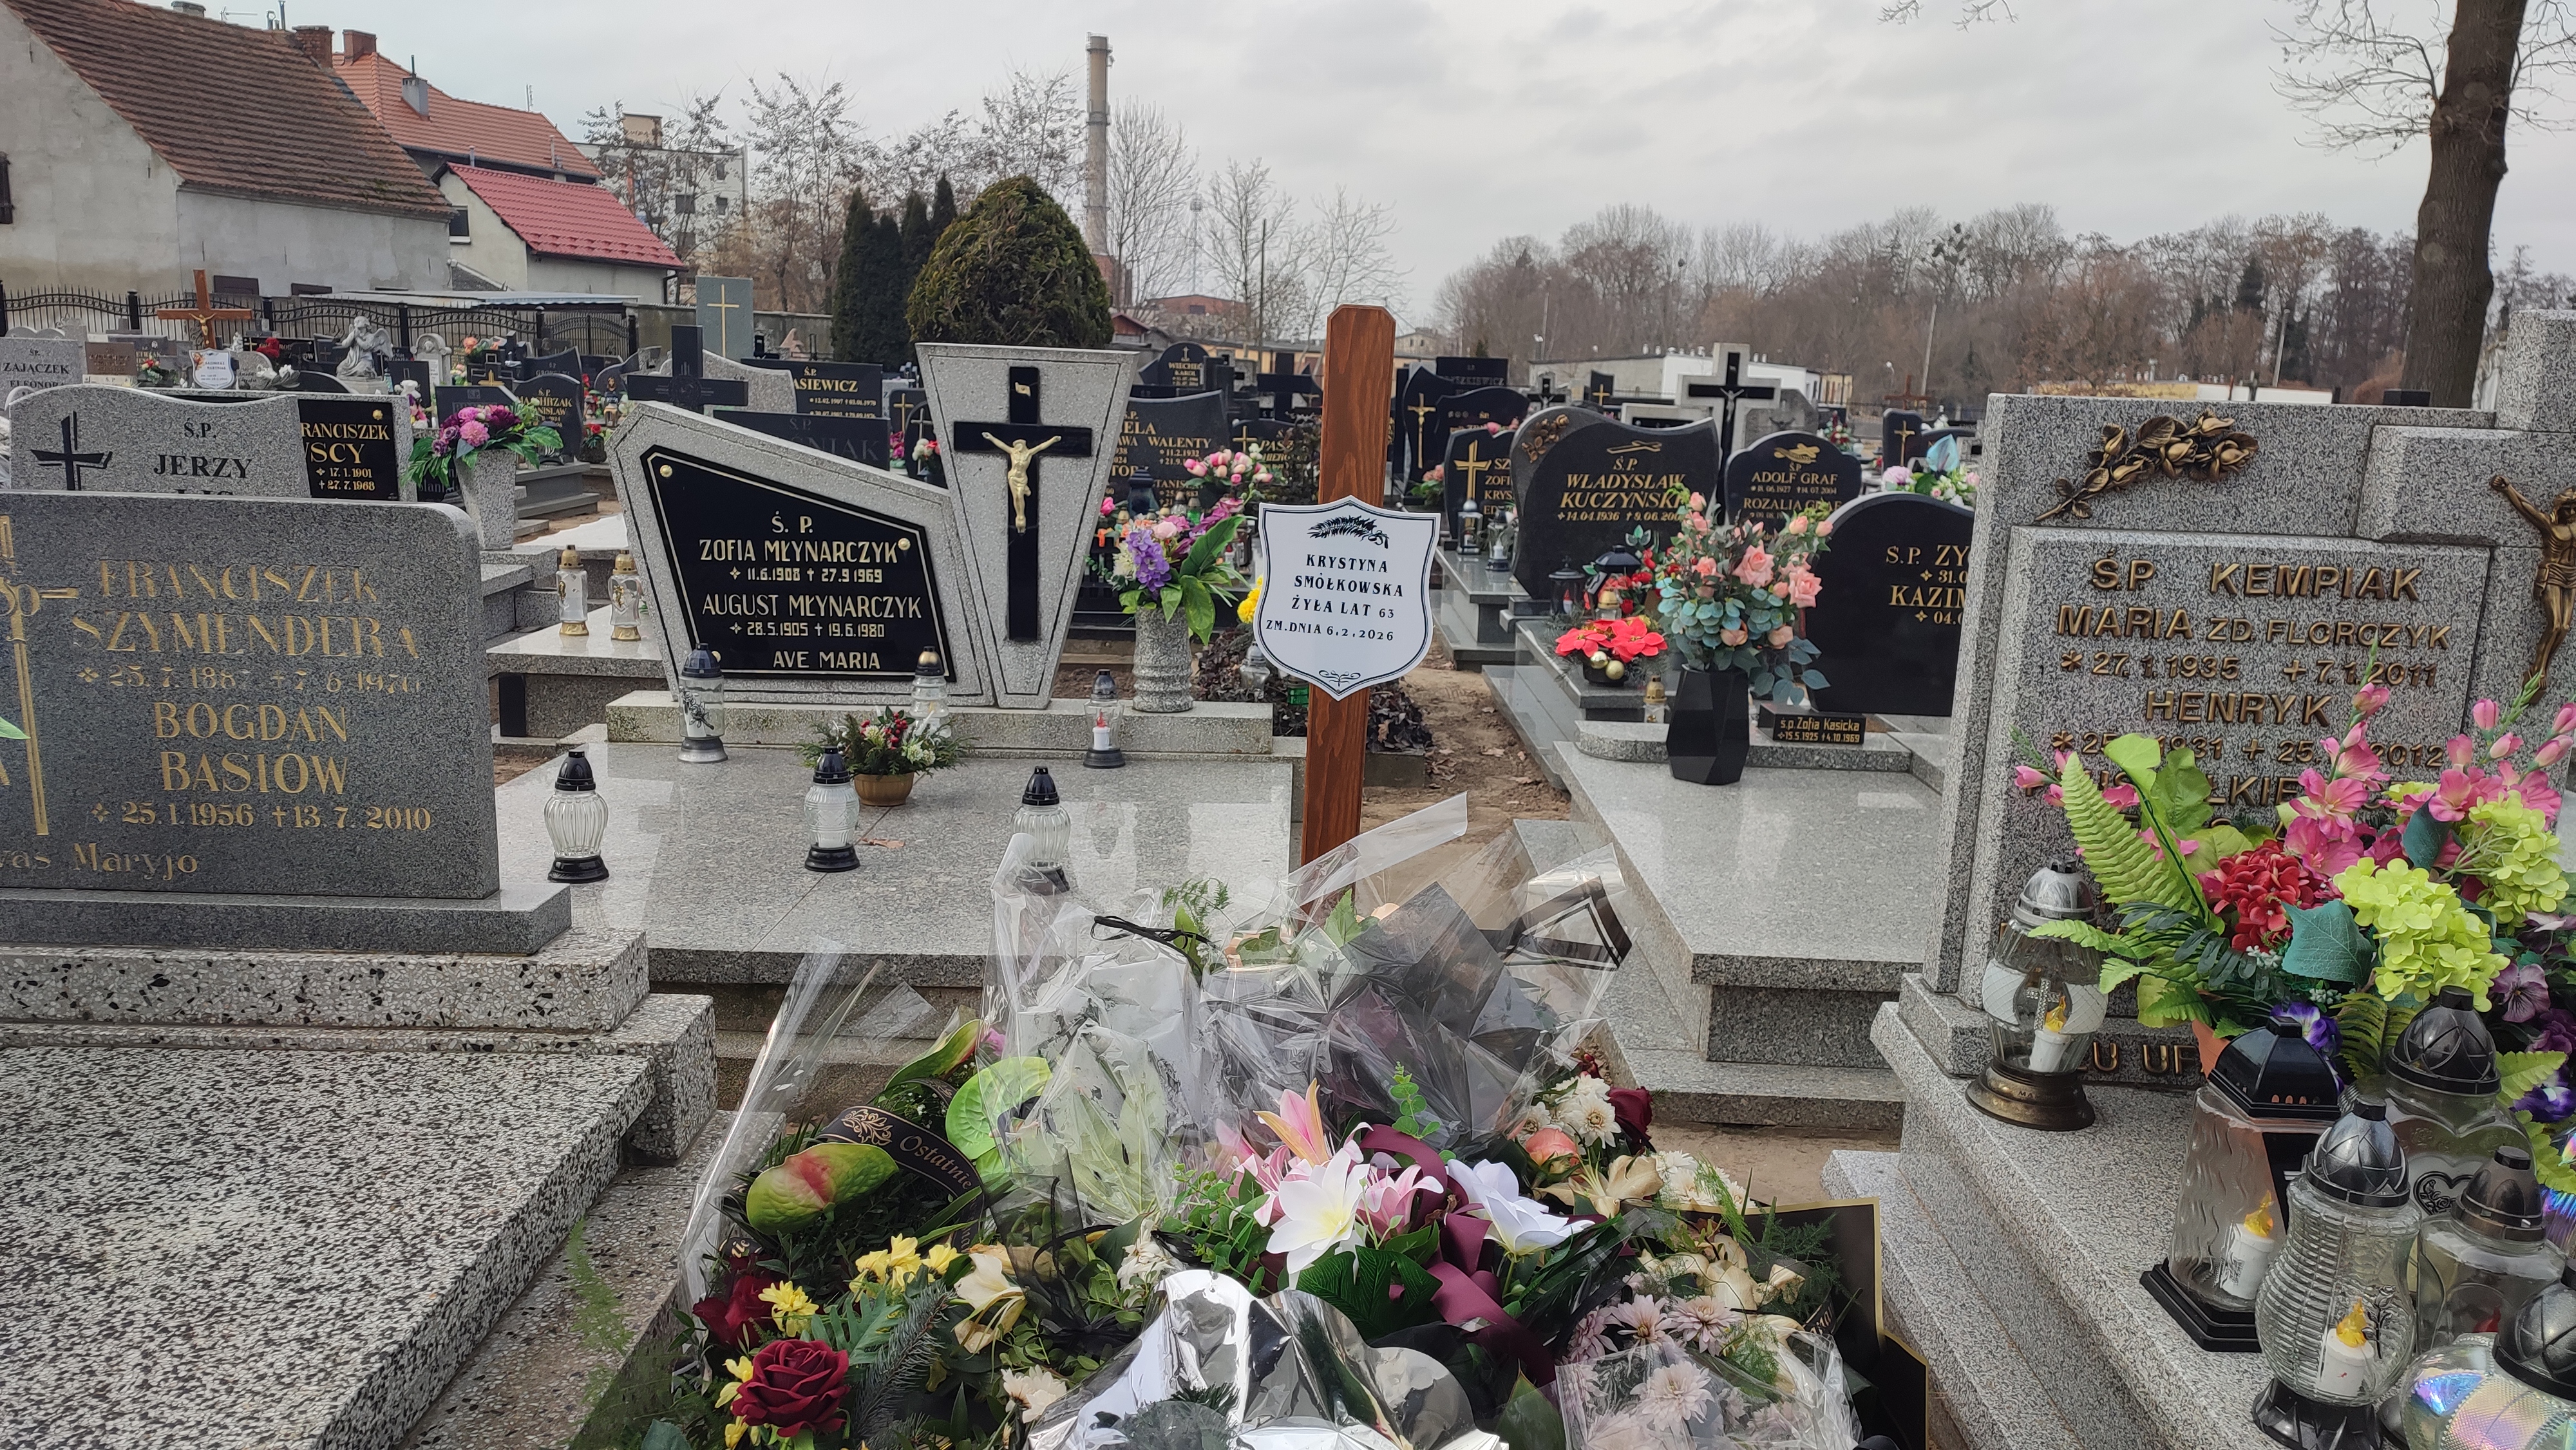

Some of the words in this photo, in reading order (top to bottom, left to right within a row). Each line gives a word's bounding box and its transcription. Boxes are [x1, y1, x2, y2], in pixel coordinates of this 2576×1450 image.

[3, 362, 70, 375] ZAJĄCZEK
[305, 442, 365, 464] SCY
[1148, 436, 1212, 449] WALENTY
[153, 454, 252, 478] JERZY
[1752, 471, 1797, 484] ADOLF
[1801, 473, 1839, 485] GRAF
[1743, 498, 1802, 511] ROZALIA
[699, 539, 756, 561] ZOFIA
[764, 540, 898, 563] MŁYNARCZYK
[1935, 544, 1971, 567] ZY
[747, 567, 800, 581] 11.6.1908
[1306, 554, 1388, 573] KRYSTYNA
[1294, 573, 1403, 598] SMÓŁKOWSKA
[2210, 561, 2423, 601] KEMPIAK
[702, 593, 779, 616] AUGUST
[788, 594, 922, 619] MŁYNARCZYK
[1291, 594, 1333, 614] ŻYŁA
[1340, 601, 1371, 616] LAT
[1379, 608, 1394, 619] 63
[747, 621, 809, 636] 28.5.1905
[828, 623, 885, 637] 19.6.1980
[2056, 604, 2192, 639] MARIA
[2266, 618, 2452, 650] FLORCZYK
[773, 650, 810, 668] AVE
[819, 651, 881, 670] MARIA
[2145, 689, 2333, 727] HENRYK
[154, 702, 348, 742] BOGDAN
[1797, 717, 1820, 731] Zofia
[1823, 717, 1860, 731] Kasicka
[1826, 733, 1860, 743] 4.10.1969
[73, 842, 198, 881] Maryjo
[899, 1135, 972, 1190] Ostatnie
